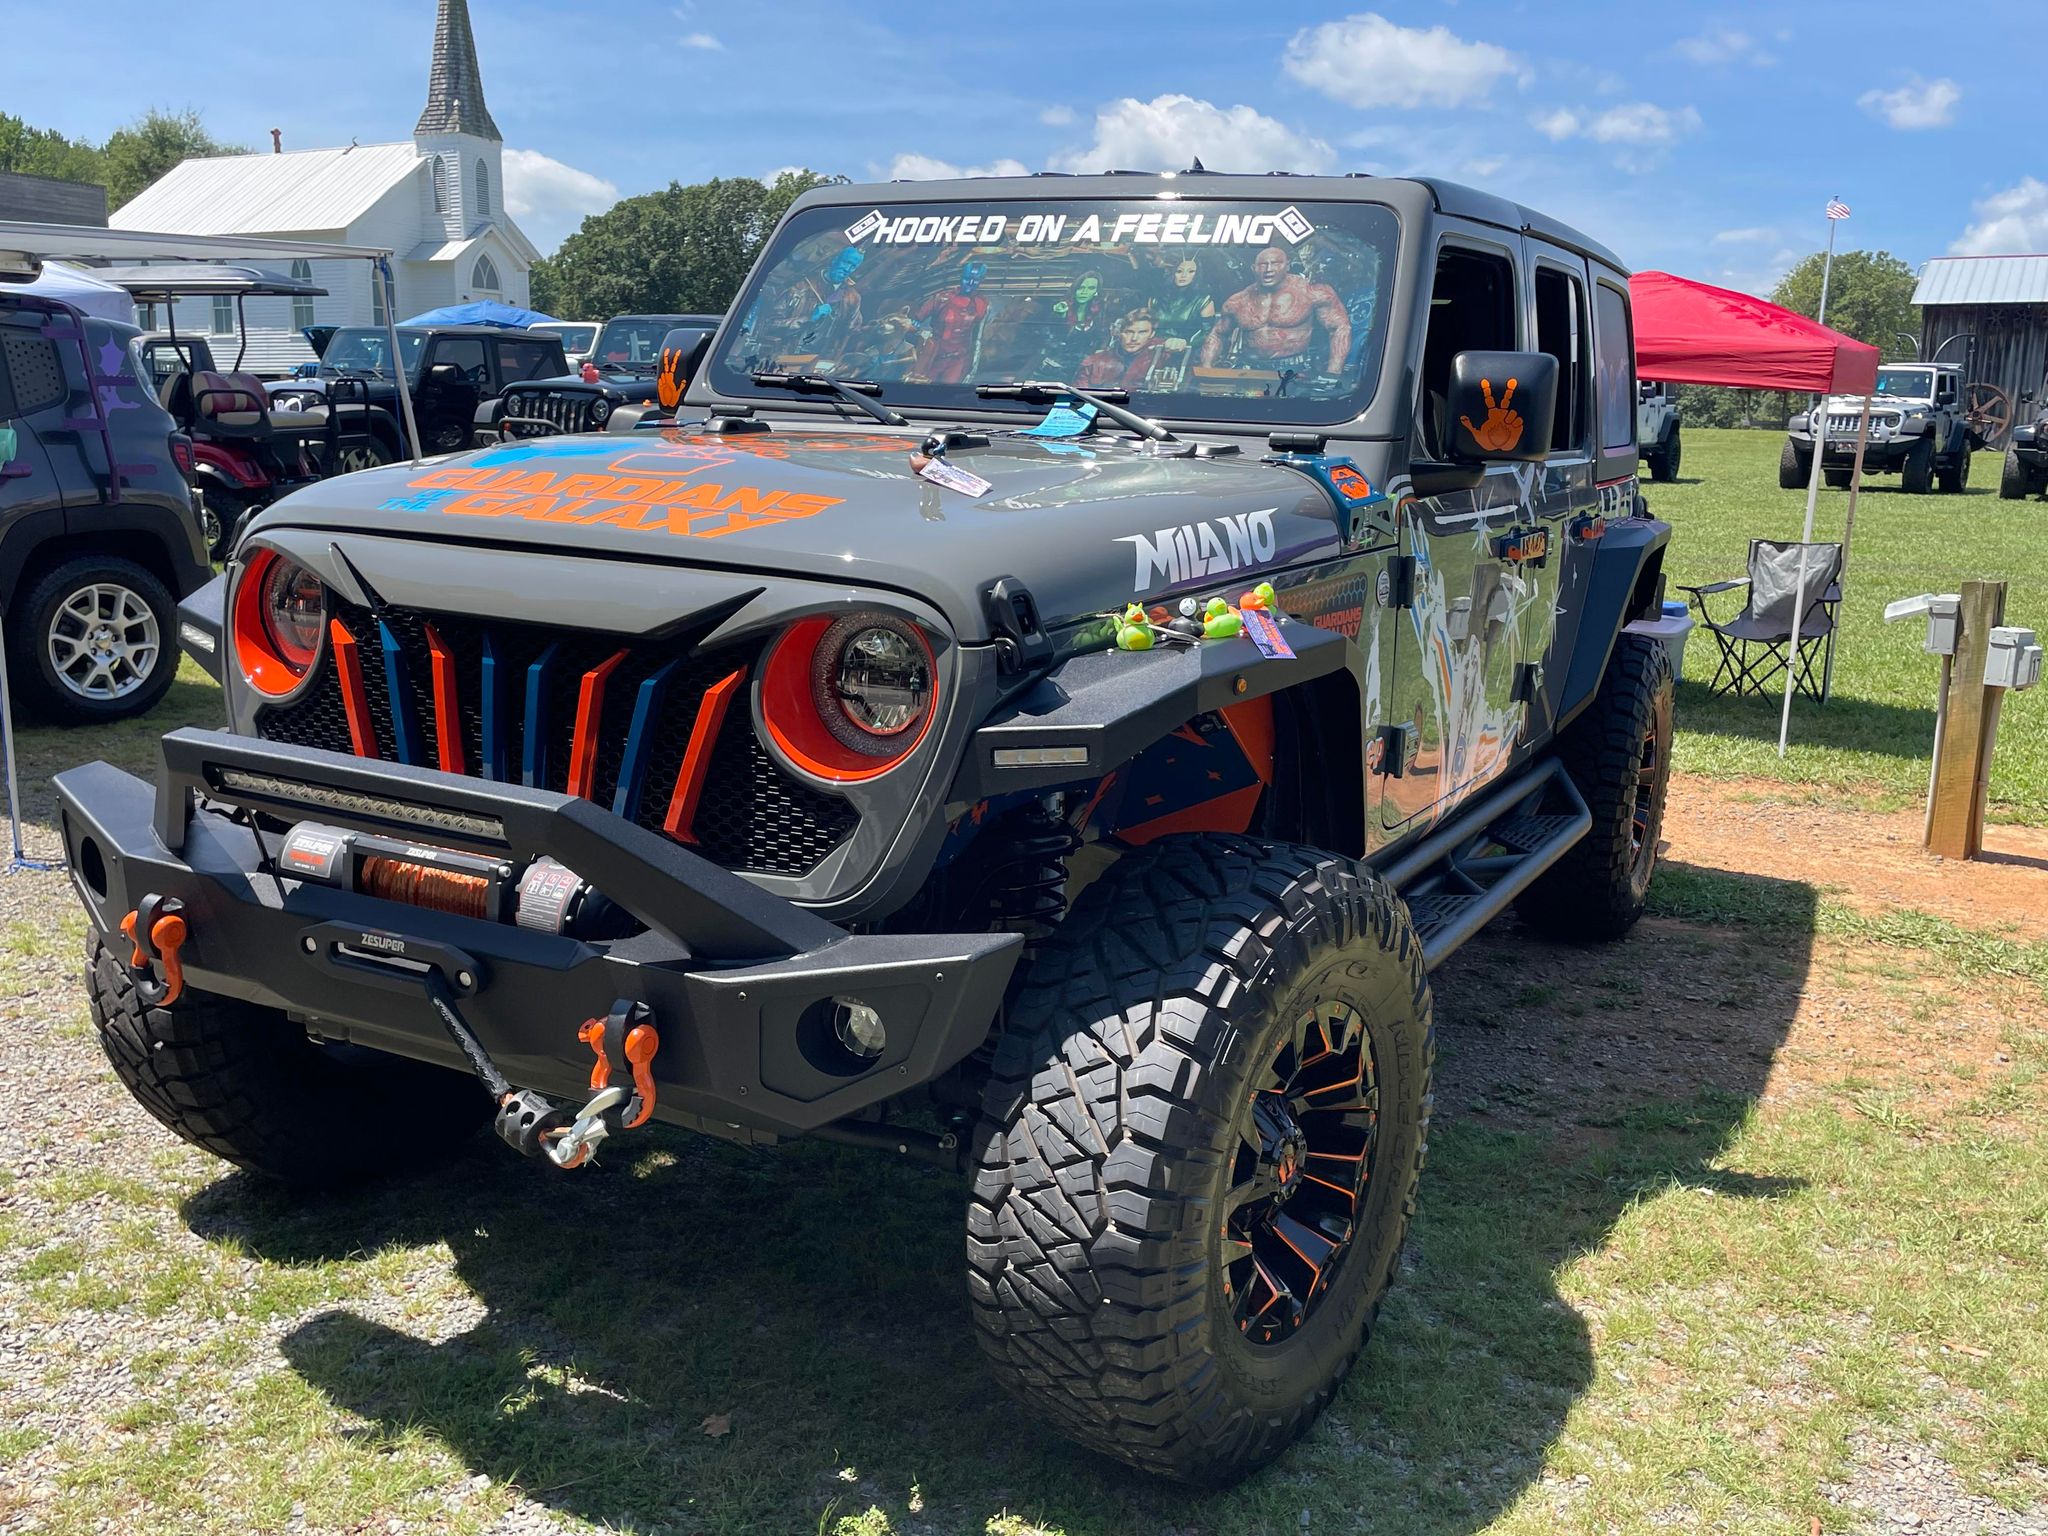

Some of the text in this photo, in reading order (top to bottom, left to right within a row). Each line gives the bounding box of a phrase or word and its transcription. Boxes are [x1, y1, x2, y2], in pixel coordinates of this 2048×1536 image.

[872, 213, 1280, 245] HOOKED ON A FEELING
[376, 497, 440, 512] THE
[406, 468, 847, 519] GUARDIANS
[414, 489, 463, 500] OF
[442, 492, 790, 539] GALAXY
[1112, 507, 1279, 592] MILANO
[1313, 606, 1362, 629] GUARDIANS
[361, 932, 405, 953] ZESUPER
